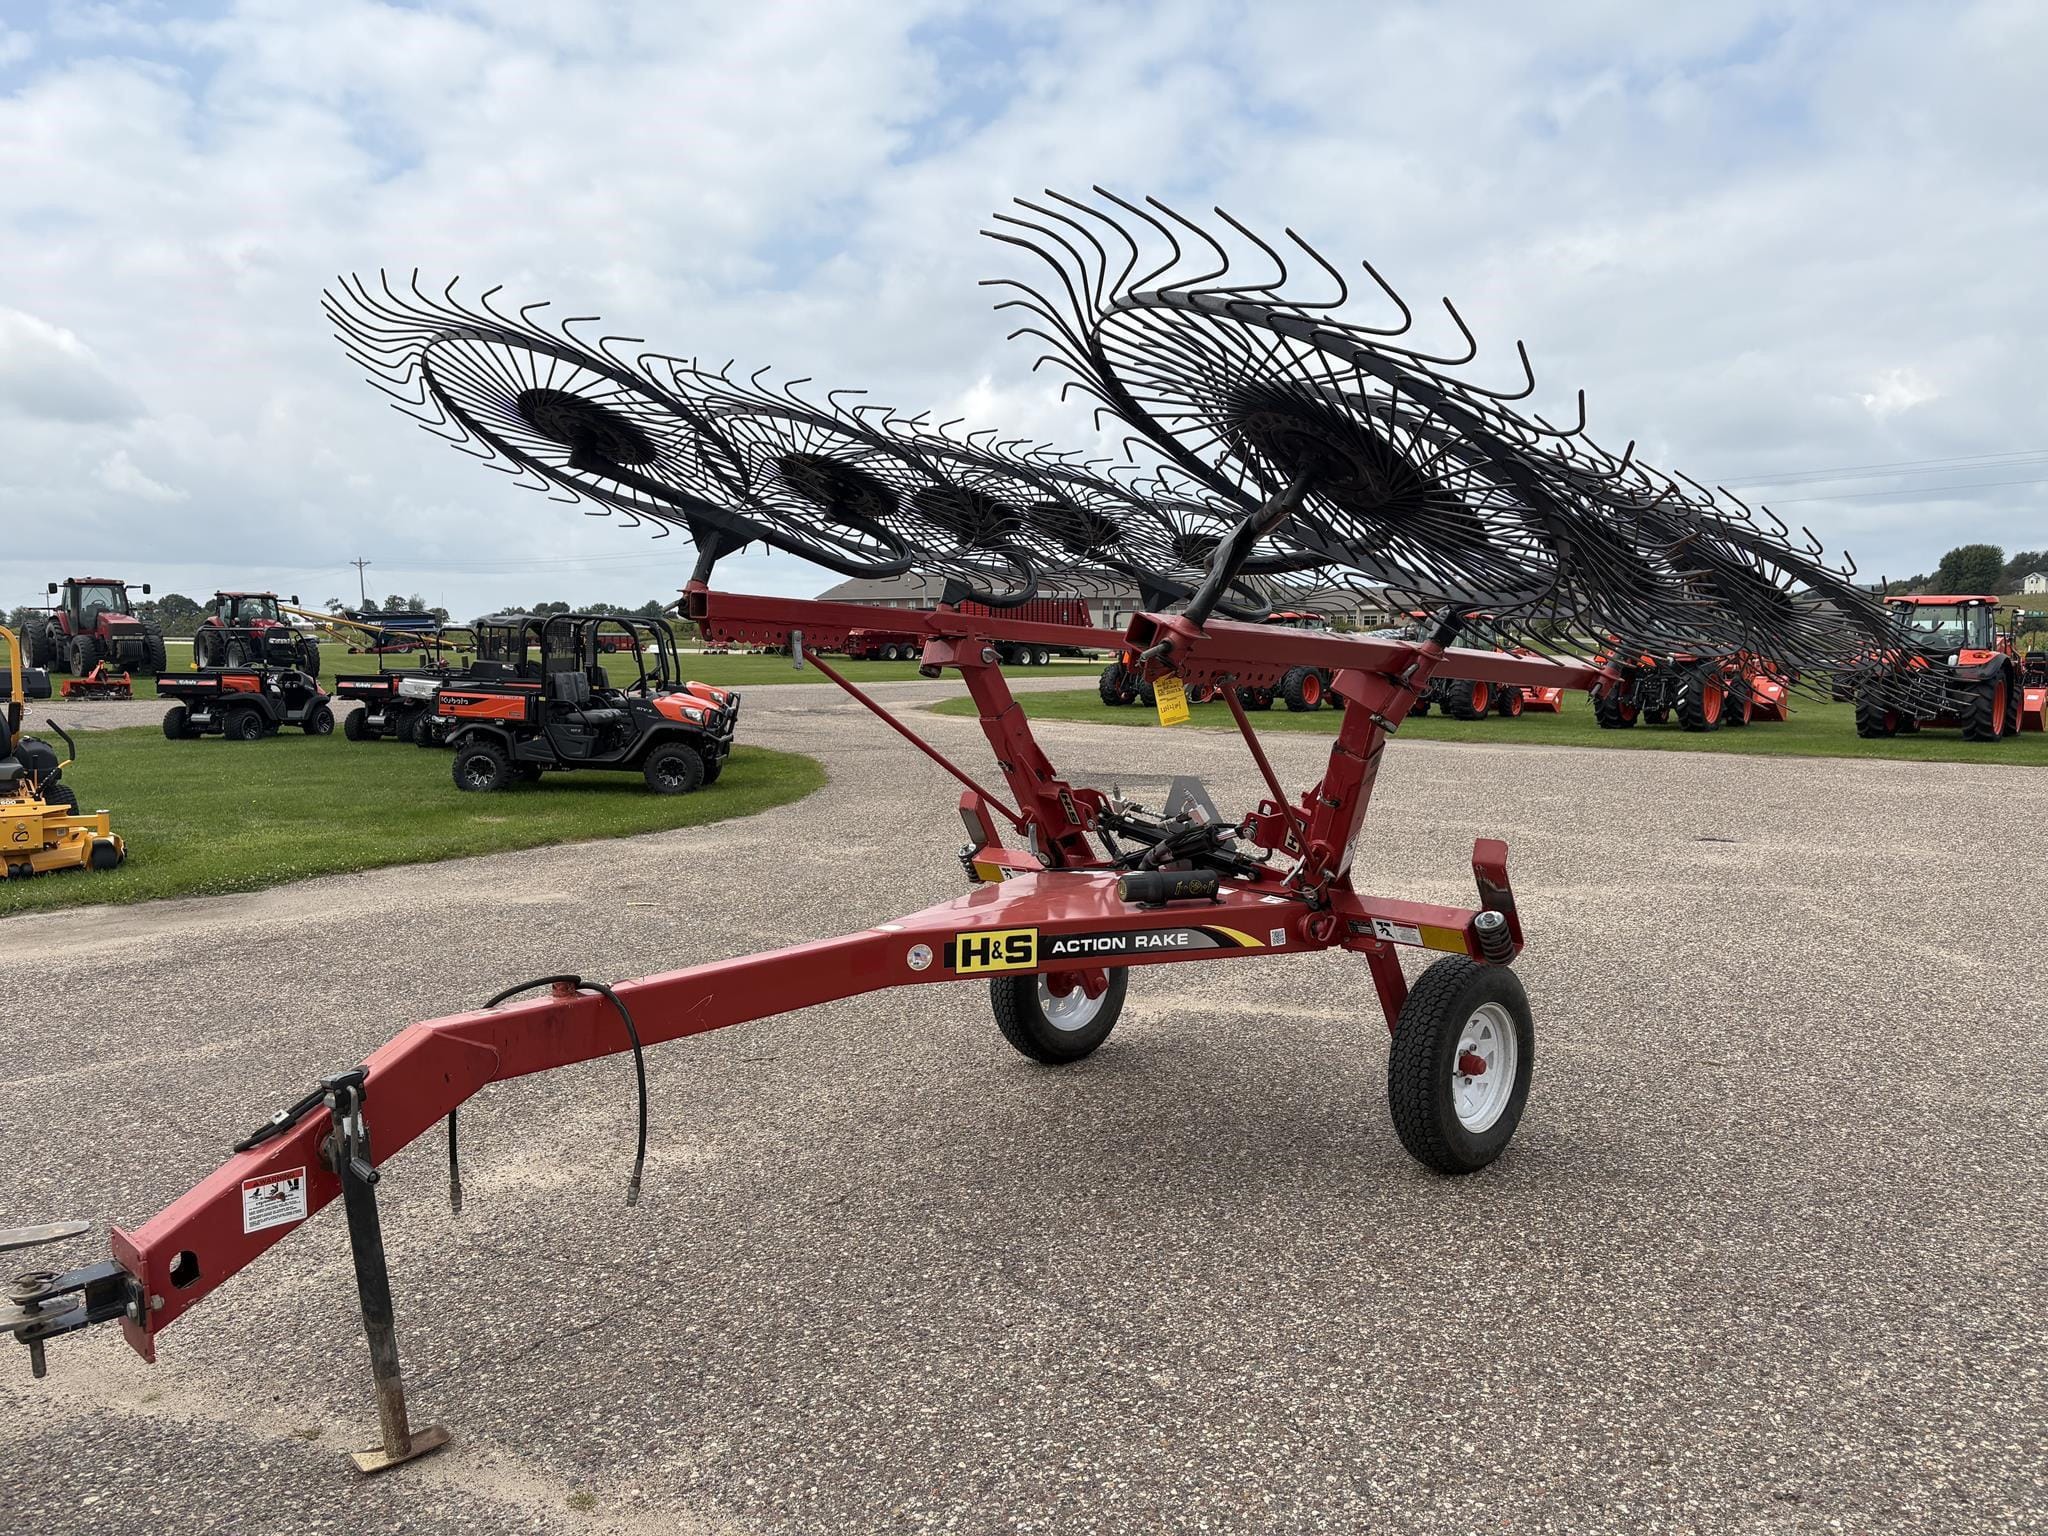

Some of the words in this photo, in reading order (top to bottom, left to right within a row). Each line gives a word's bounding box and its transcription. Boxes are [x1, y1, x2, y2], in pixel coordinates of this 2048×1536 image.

[441, 696, 469, 705] Kubota
[962, 934, 1032, 968] H&S
[1052, 936, 1126, 954] ACTION
[1135, 933, 1189, 948] RAKE
